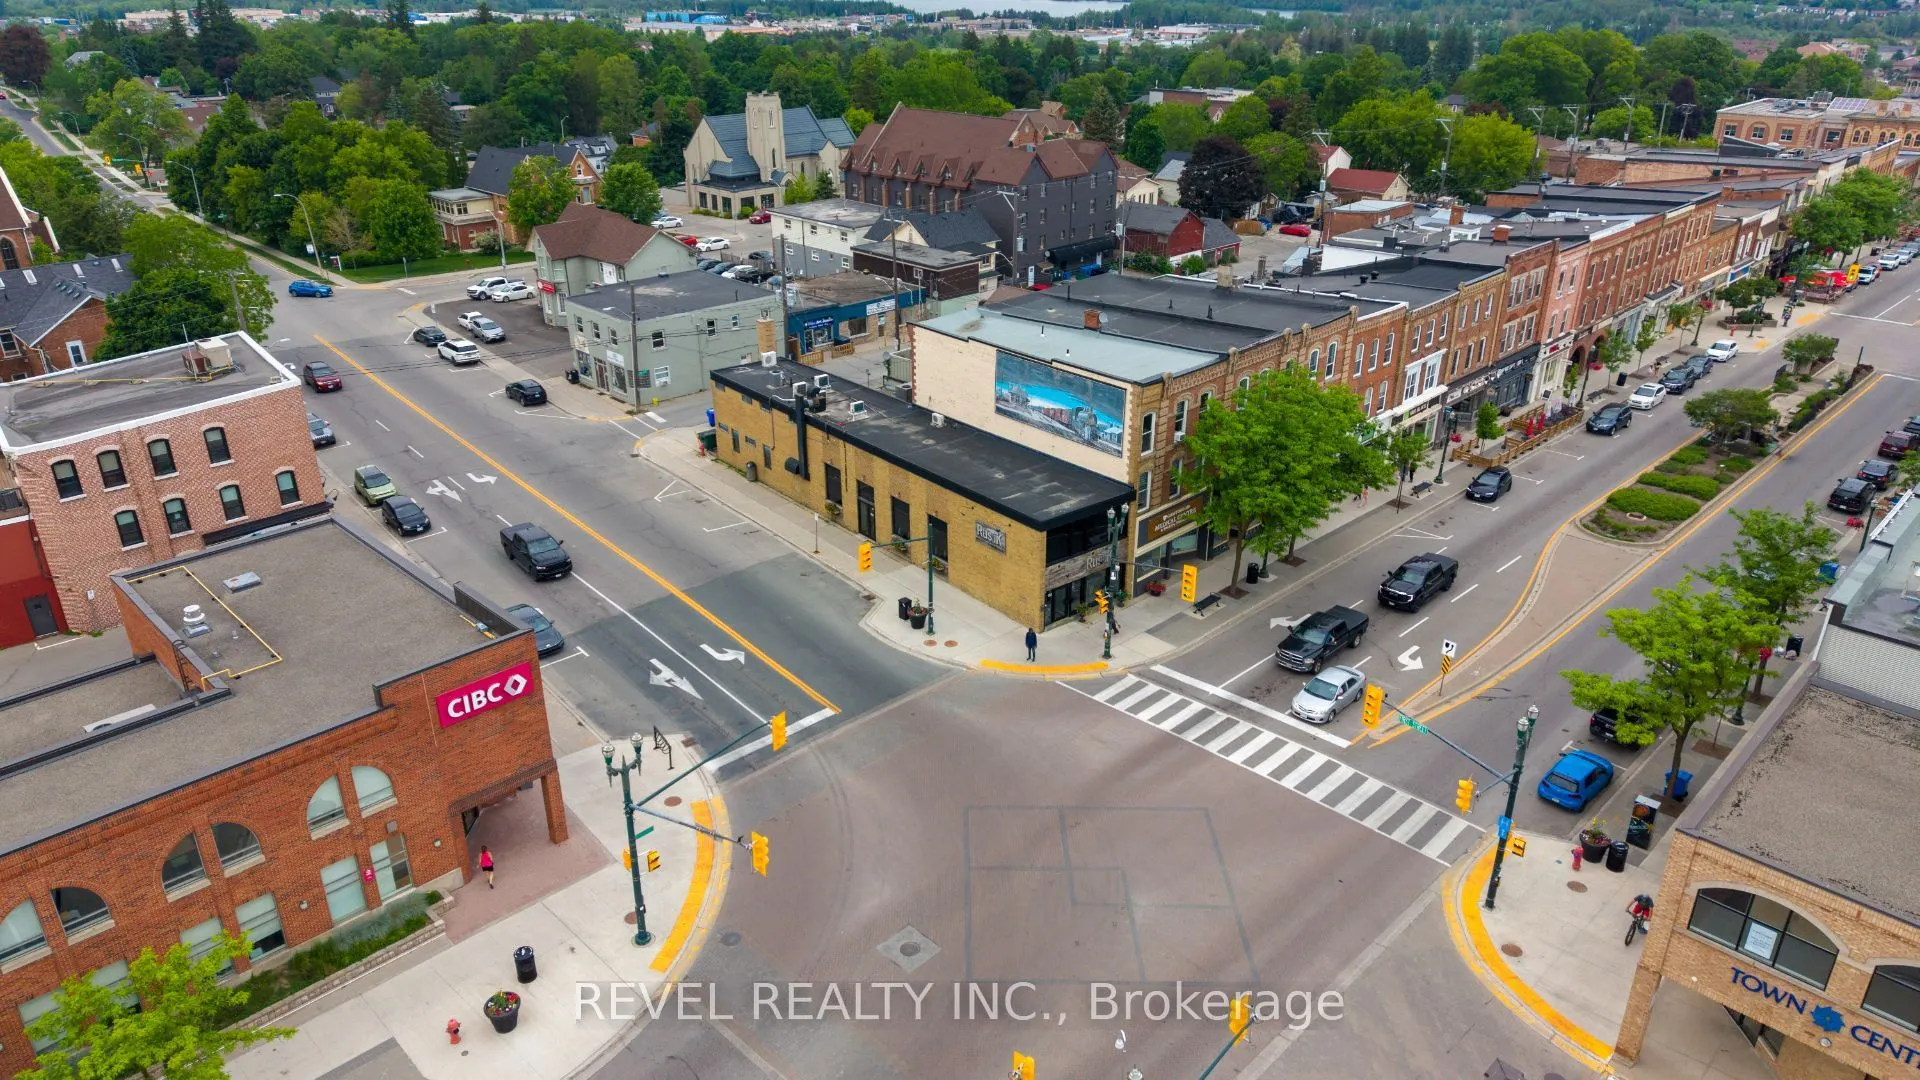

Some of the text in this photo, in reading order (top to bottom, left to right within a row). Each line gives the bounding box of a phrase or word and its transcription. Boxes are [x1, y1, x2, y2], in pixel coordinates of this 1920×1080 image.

[1154, 516, 1176, 532] MEDICAL
[447, 682, 503, 718] CIBC
[1731, 966, 1920, 1069] TOWN CENT
